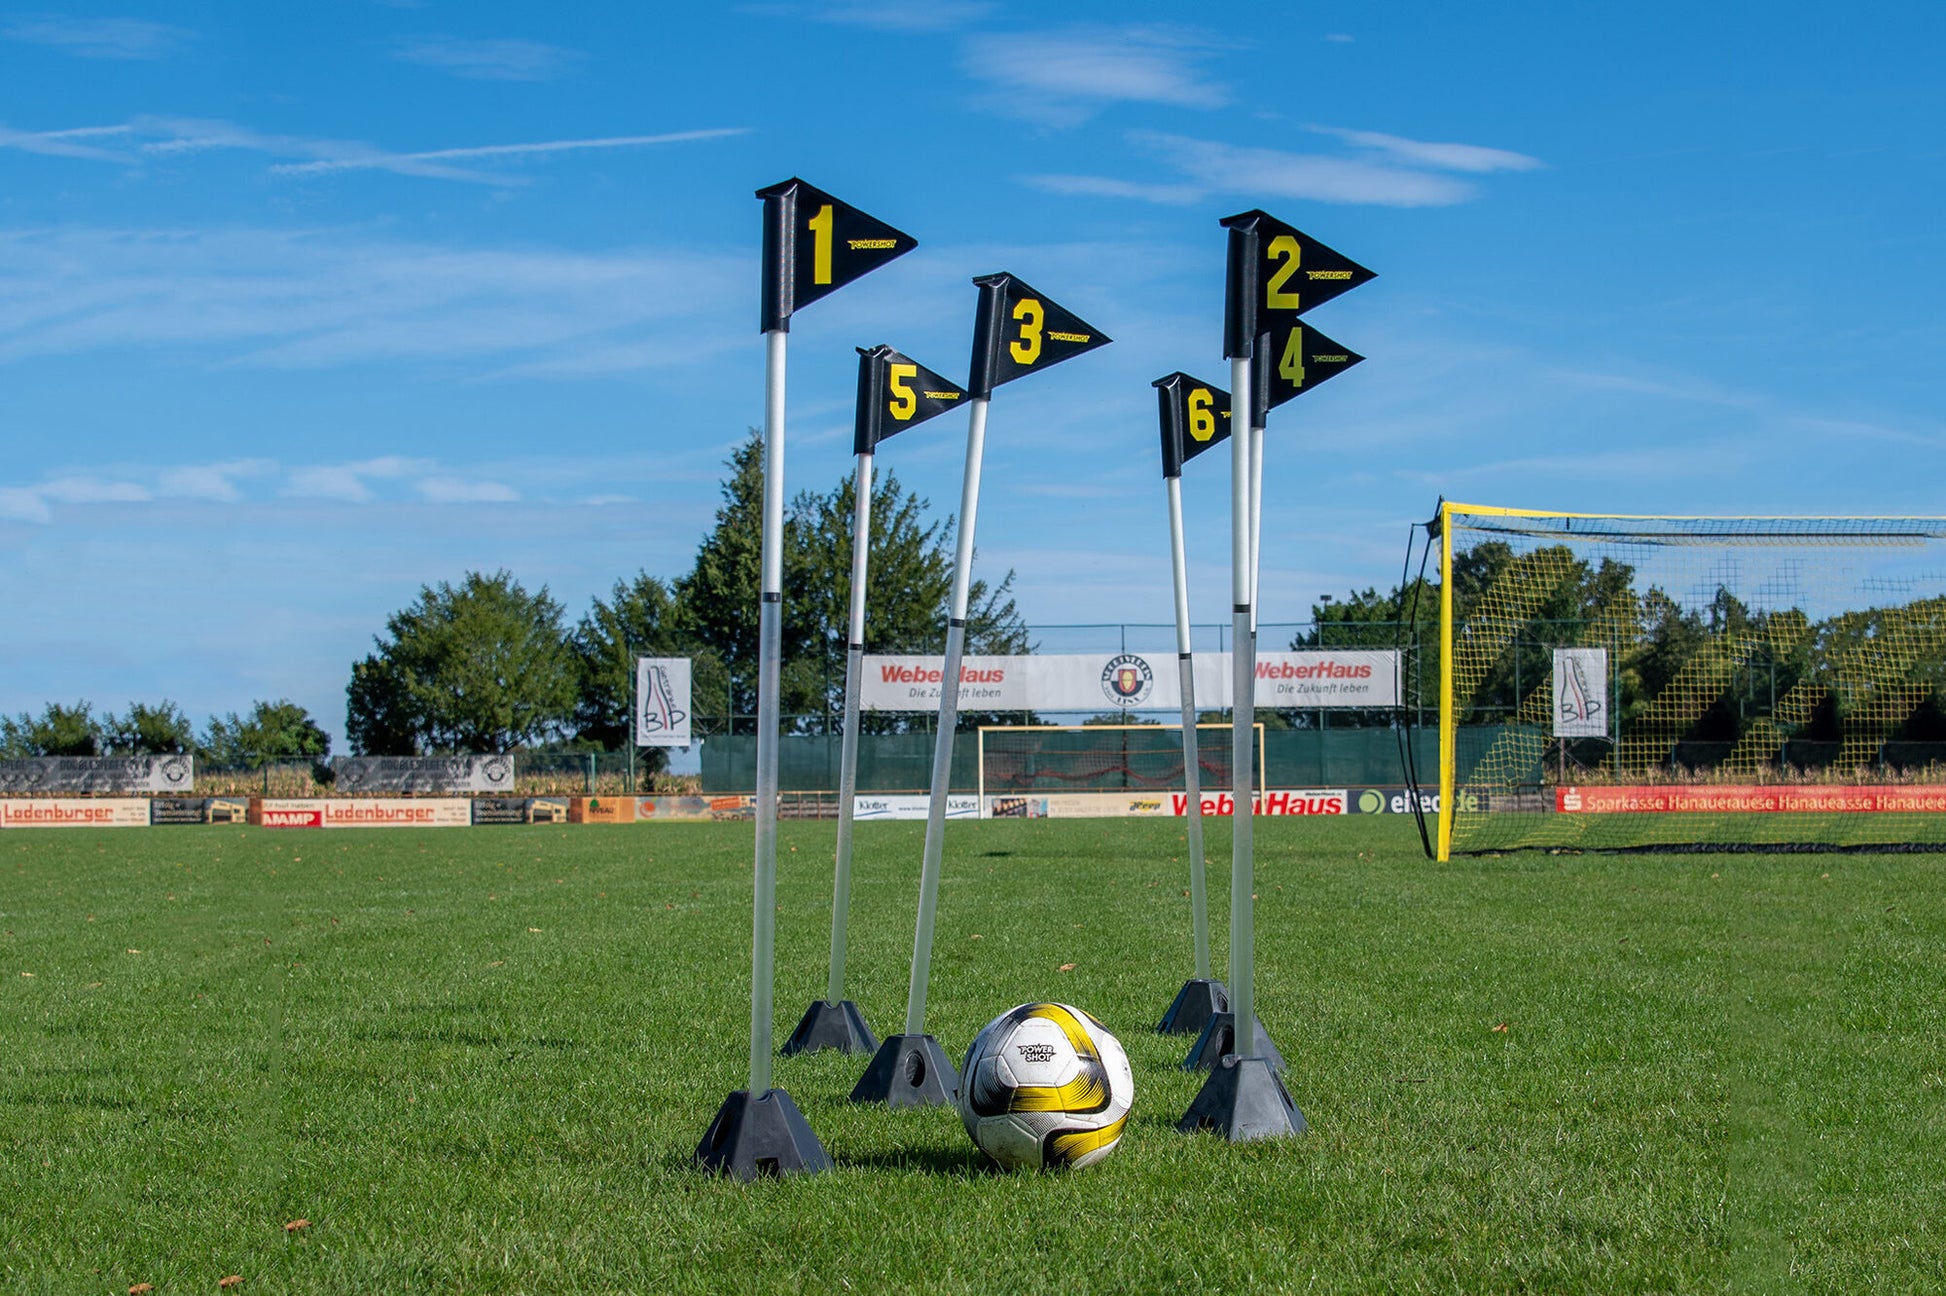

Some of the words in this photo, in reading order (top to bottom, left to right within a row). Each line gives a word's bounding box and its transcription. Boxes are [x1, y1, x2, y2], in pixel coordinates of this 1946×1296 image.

[809, 205, 833, 285] 1
[847, 239, 897, 250] POWERSHOT
[1267, 235, 1301, 309] 2
[1306, 270, 1353, 280] POWERSHOT
[1010, 298, 1044, 365] 3
[1279, 327, 1305, 388] 4
[889, 363, 917, 421] 5
[1188, 387, 1215, 442] 6
[881, 665, 1005, 683] Webeaus
[1255, 661, 1372, 679] WeberHaus
[909, 688, 925, 698] Die
[972, 688, 1002, 698] leben
[1277, 684, 1293, 694] Die
[1297, 684, 1337, 696] Zukunft
[1339, 683, 1369, 694] leben
[5, 804, 114, 823] Ladenburger
[325, 804, 435, 823] Ladenburger
[1172, 793, 1342, 816] WebrHaus
[1587, 796, 1664, 812] Sparkasse
